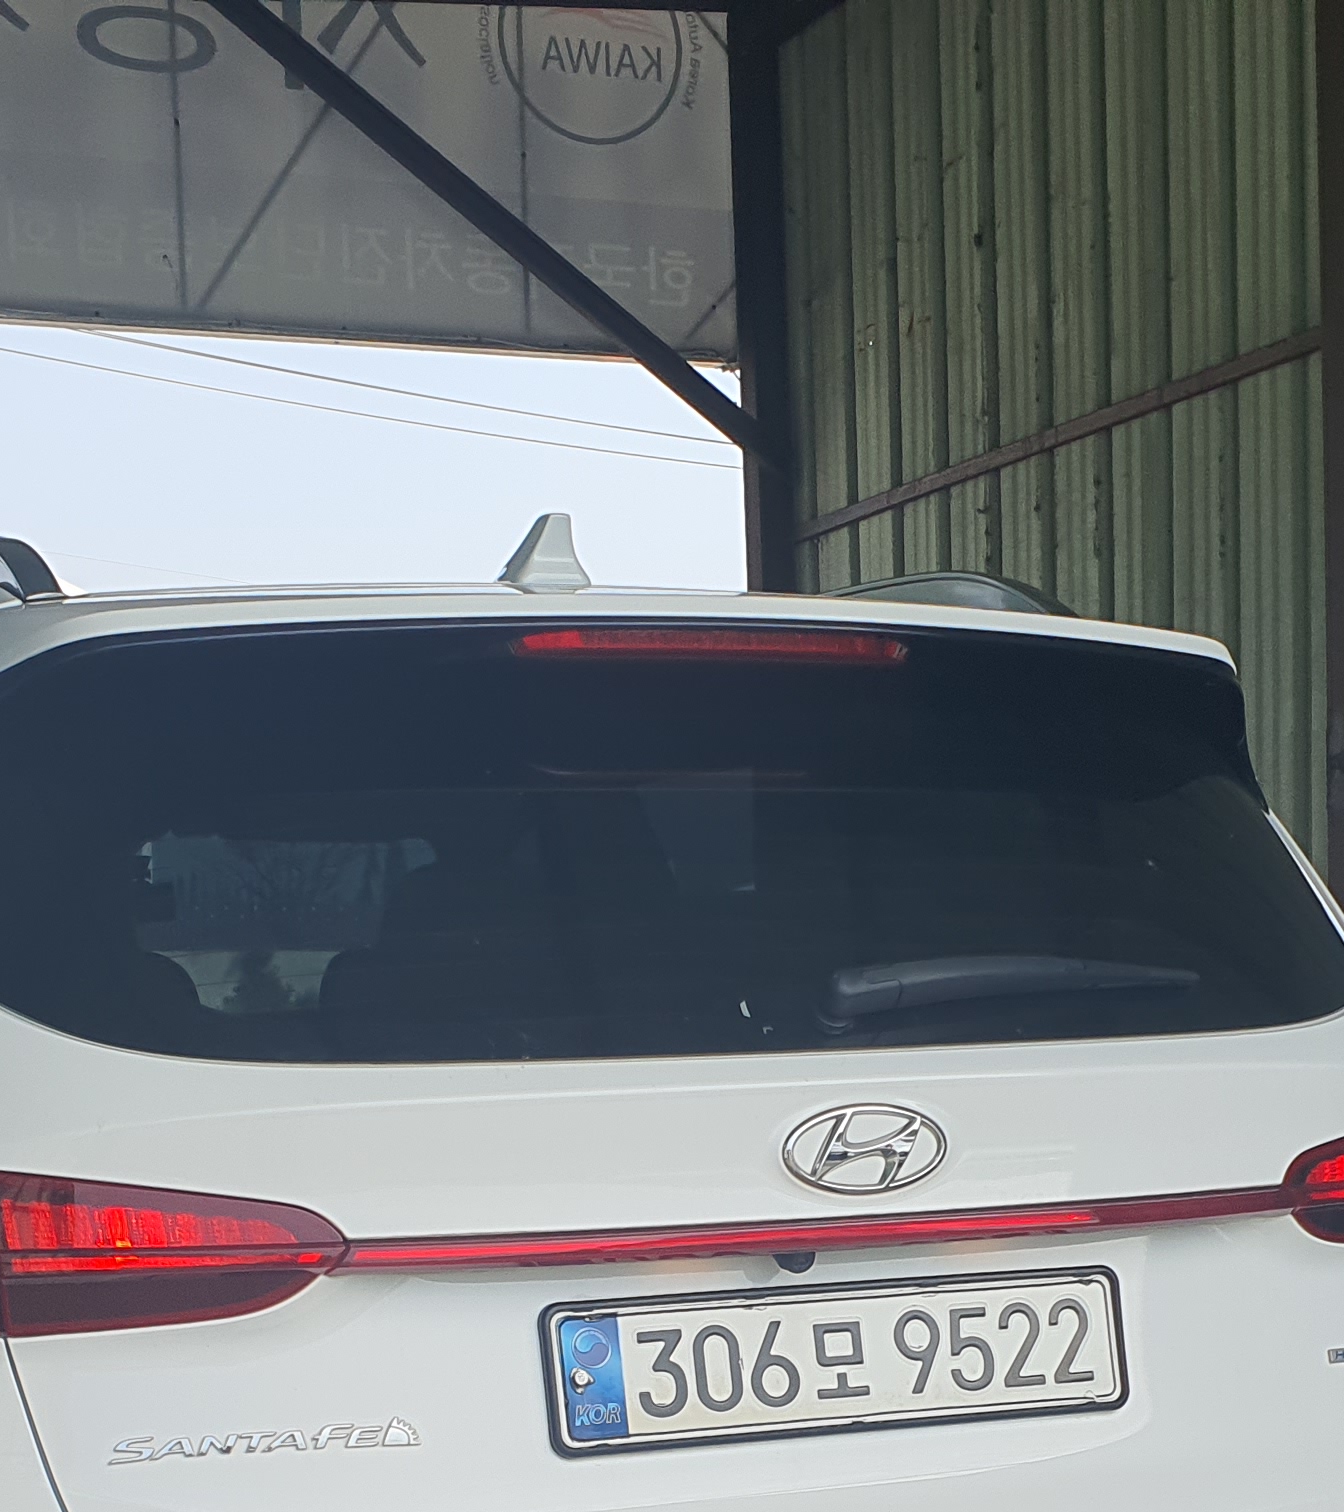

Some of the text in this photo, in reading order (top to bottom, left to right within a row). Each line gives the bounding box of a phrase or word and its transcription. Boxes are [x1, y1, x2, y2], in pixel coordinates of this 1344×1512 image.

[637, 1297, 1096, 1419] 306모 9522
[574, 1402, 622, 1428] KOR
